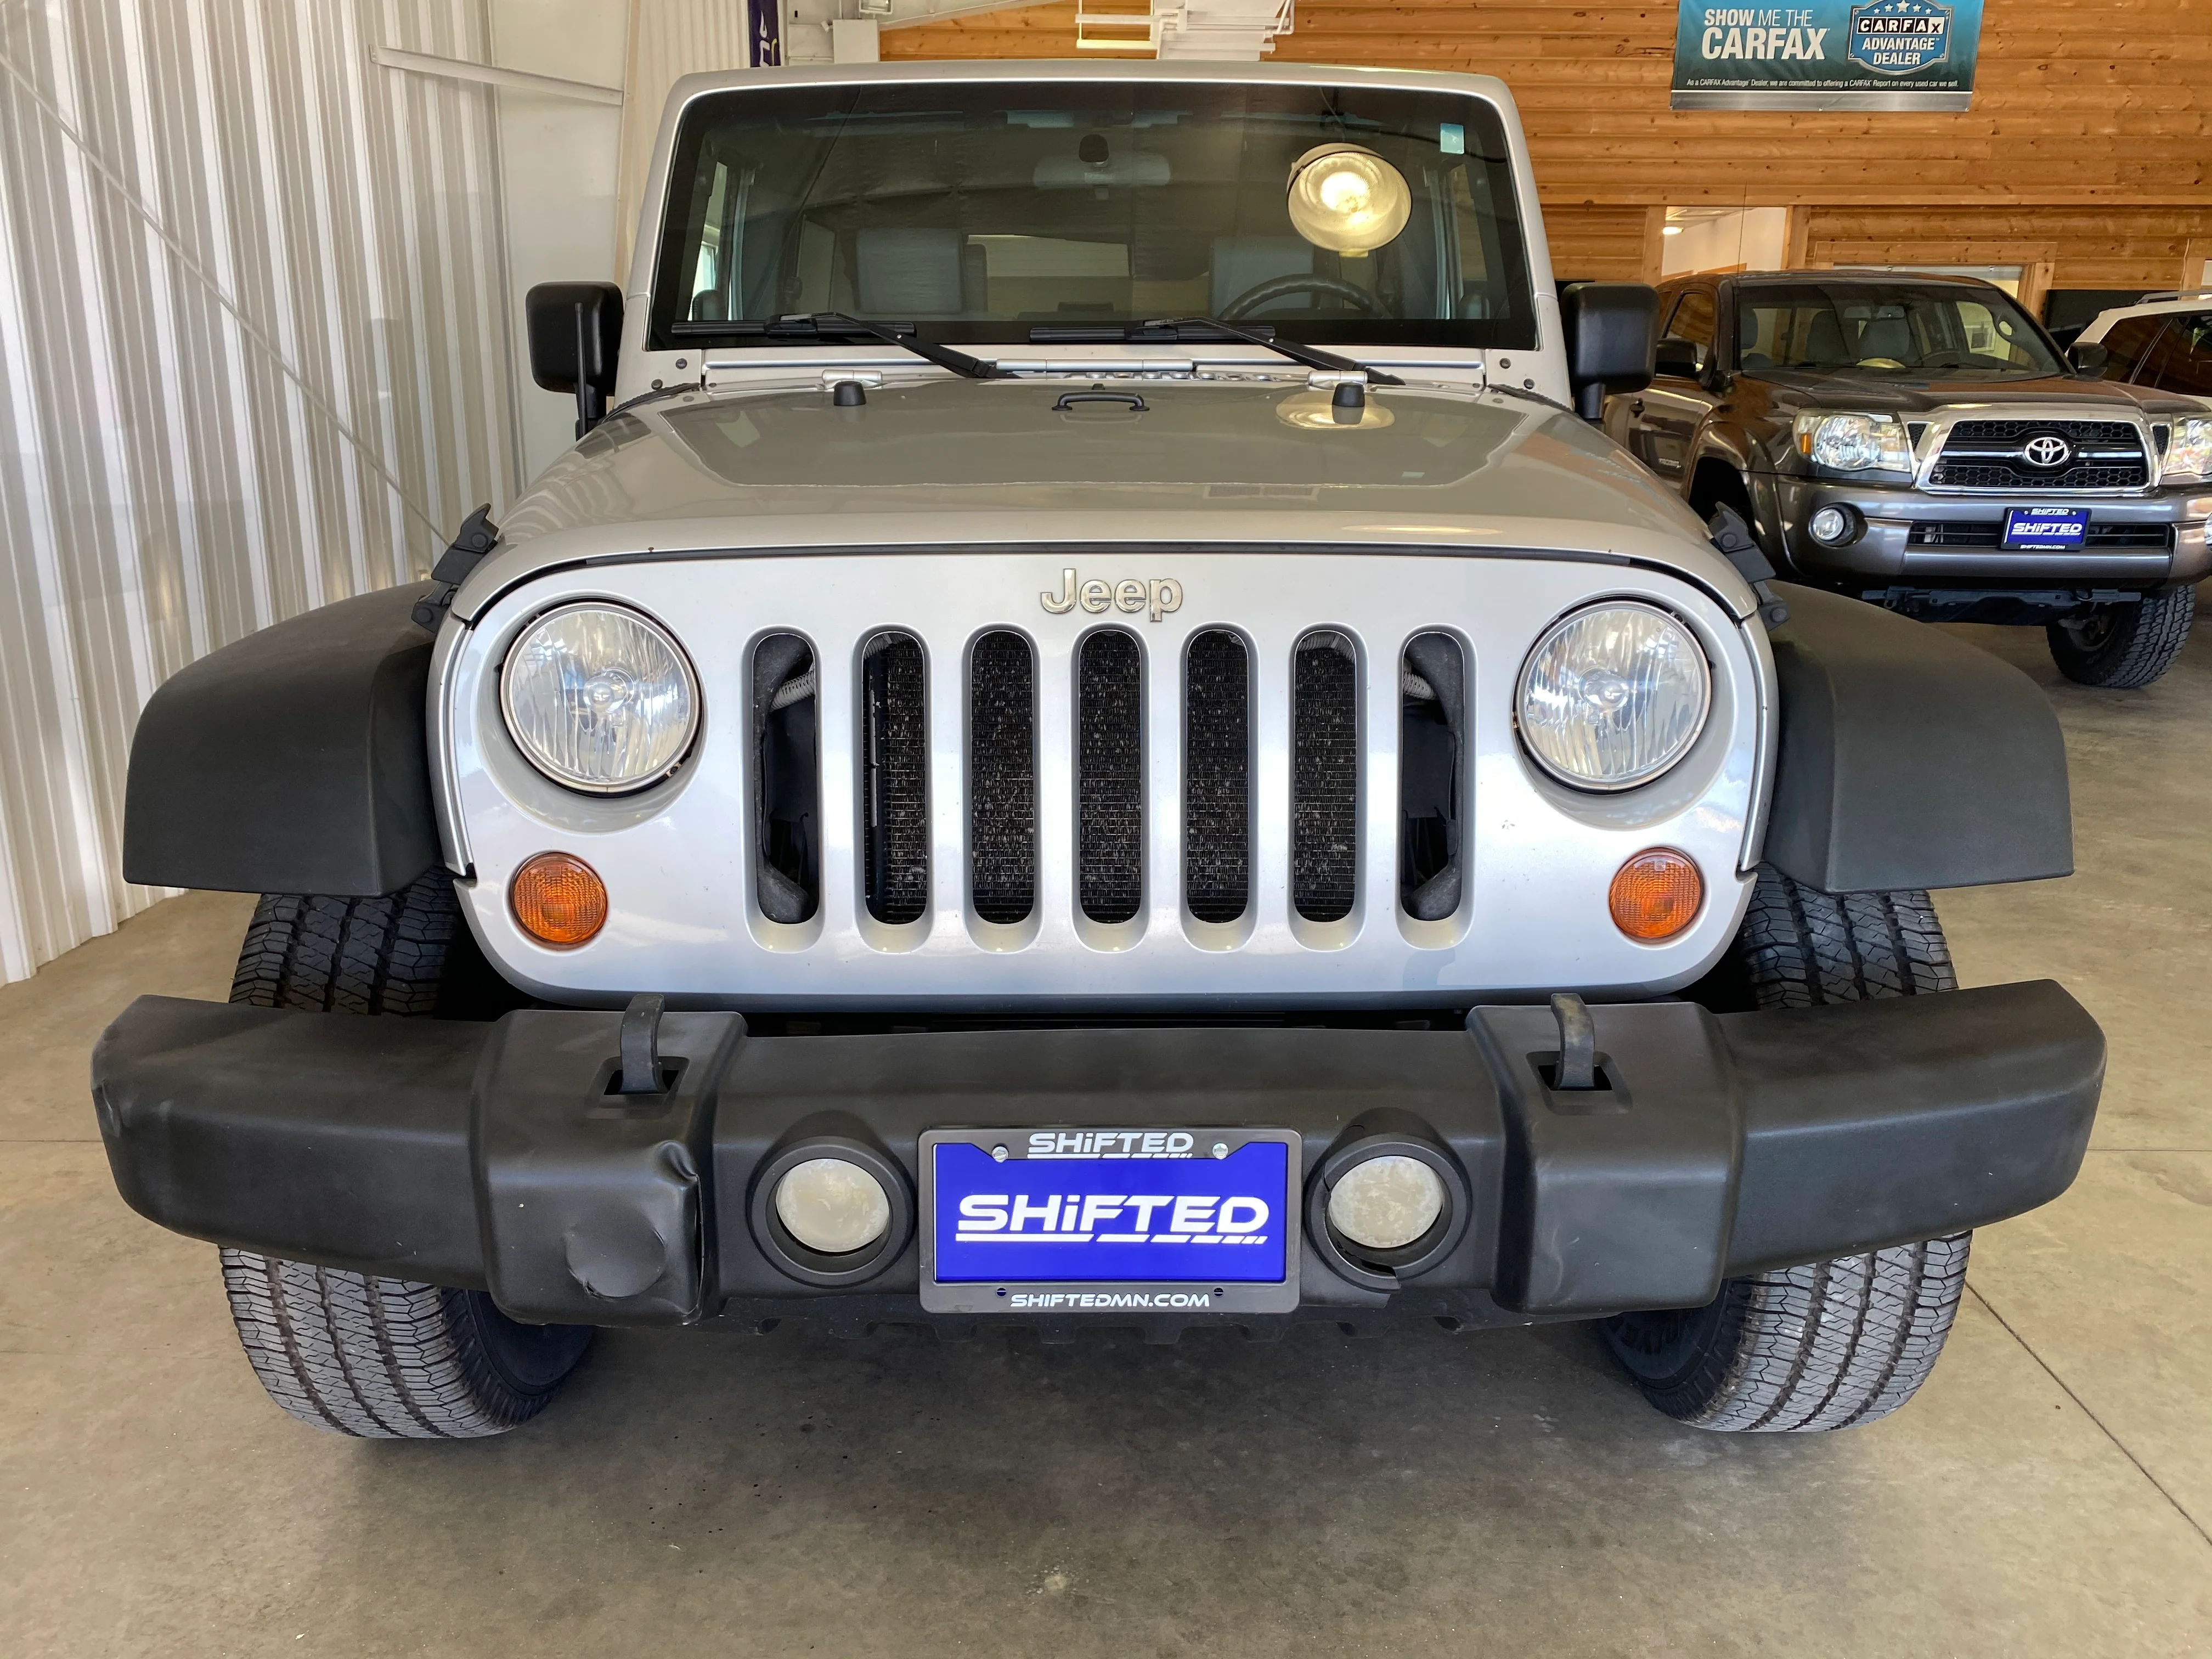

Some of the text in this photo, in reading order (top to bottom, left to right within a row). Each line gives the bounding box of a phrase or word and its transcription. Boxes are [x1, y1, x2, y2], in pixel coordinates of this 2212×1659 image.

[1704, 9, 1814, 27] SHOW ME THE
[1860, 19, 1942, 33] CARFAX
[1702, 27, 1827, 60] CARFAX
[1872, 52, 1921, 65] DEALER
[1824, 80, 1843, 88] offering
[1041, 568, 1183, 623] Jeep
[1010, 1293, 1210, 1307] SHIFTEDMN.COM
